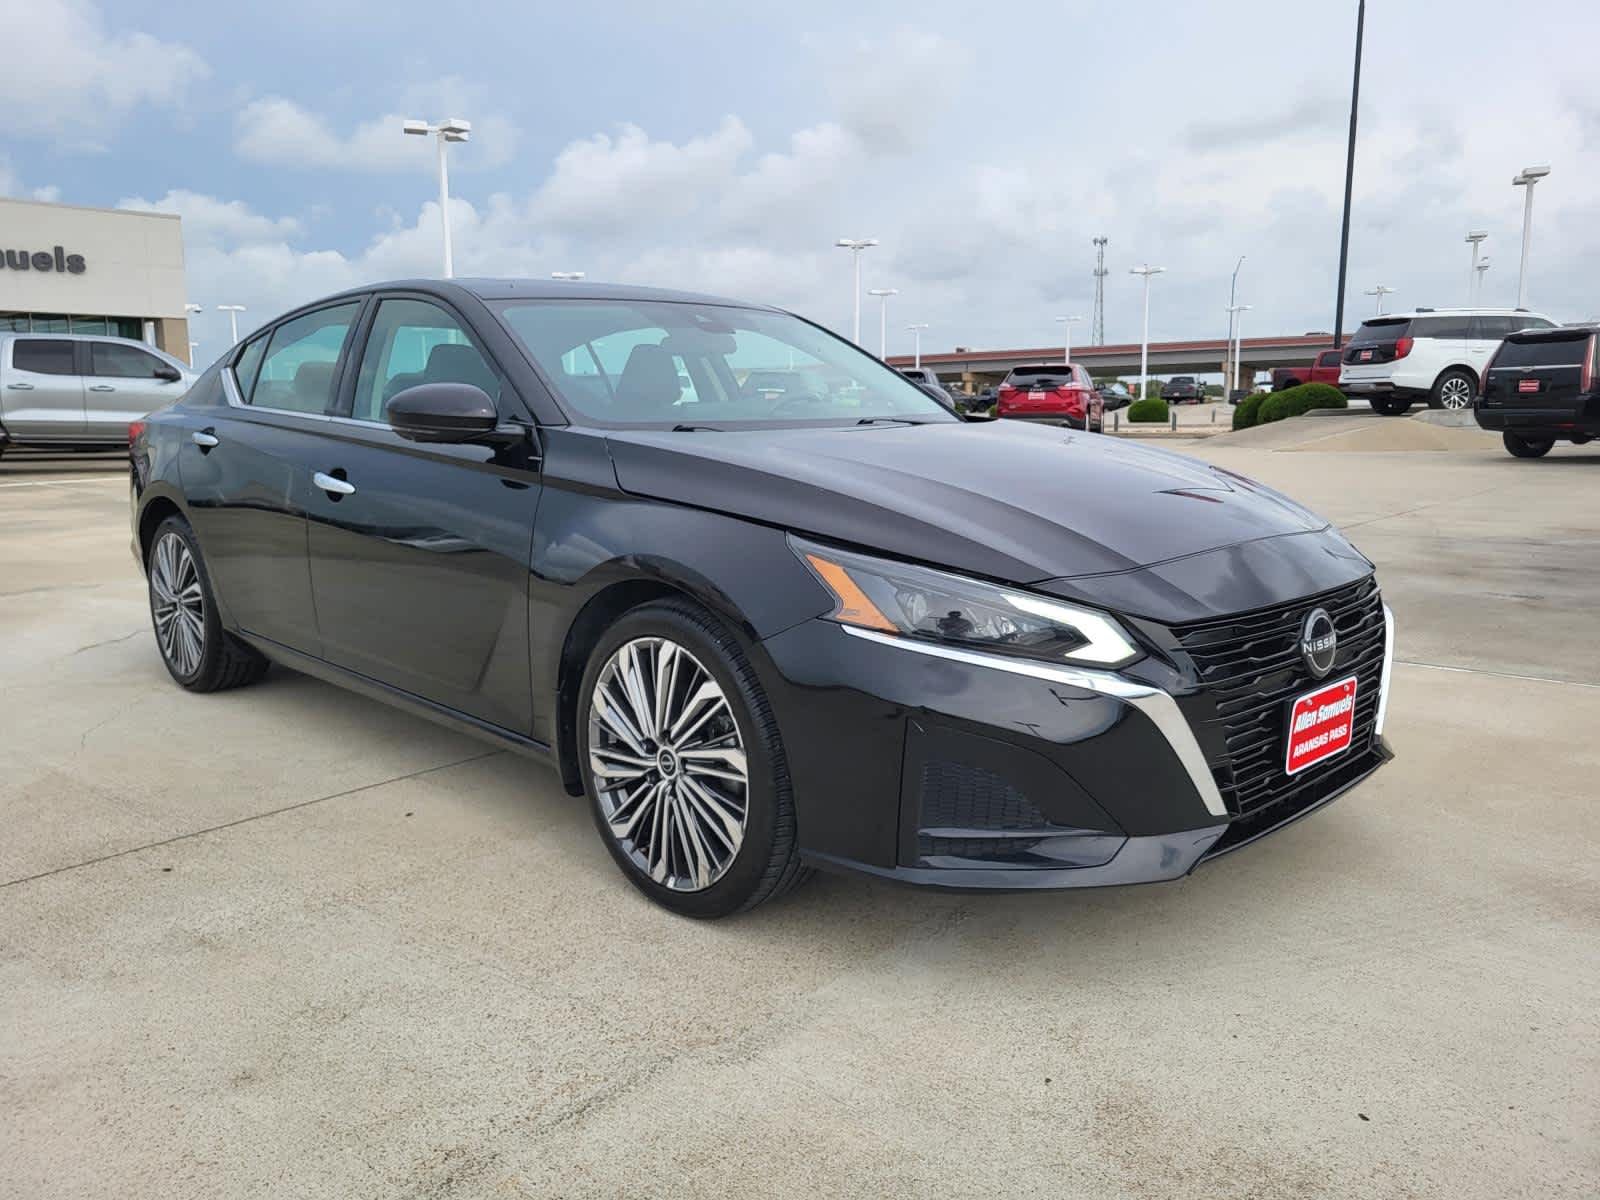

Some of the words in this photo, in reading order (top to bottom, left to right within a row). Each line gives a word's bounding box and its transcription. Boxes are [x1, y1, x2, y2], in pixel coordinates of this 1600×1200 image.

[1294, 711, 1317, 734] Allen
[1317, 694, 1353, 723] Samuels
[1293, 732, 1329, 758] ARANSAS
[1329, 724, 1348, 741] PASS
